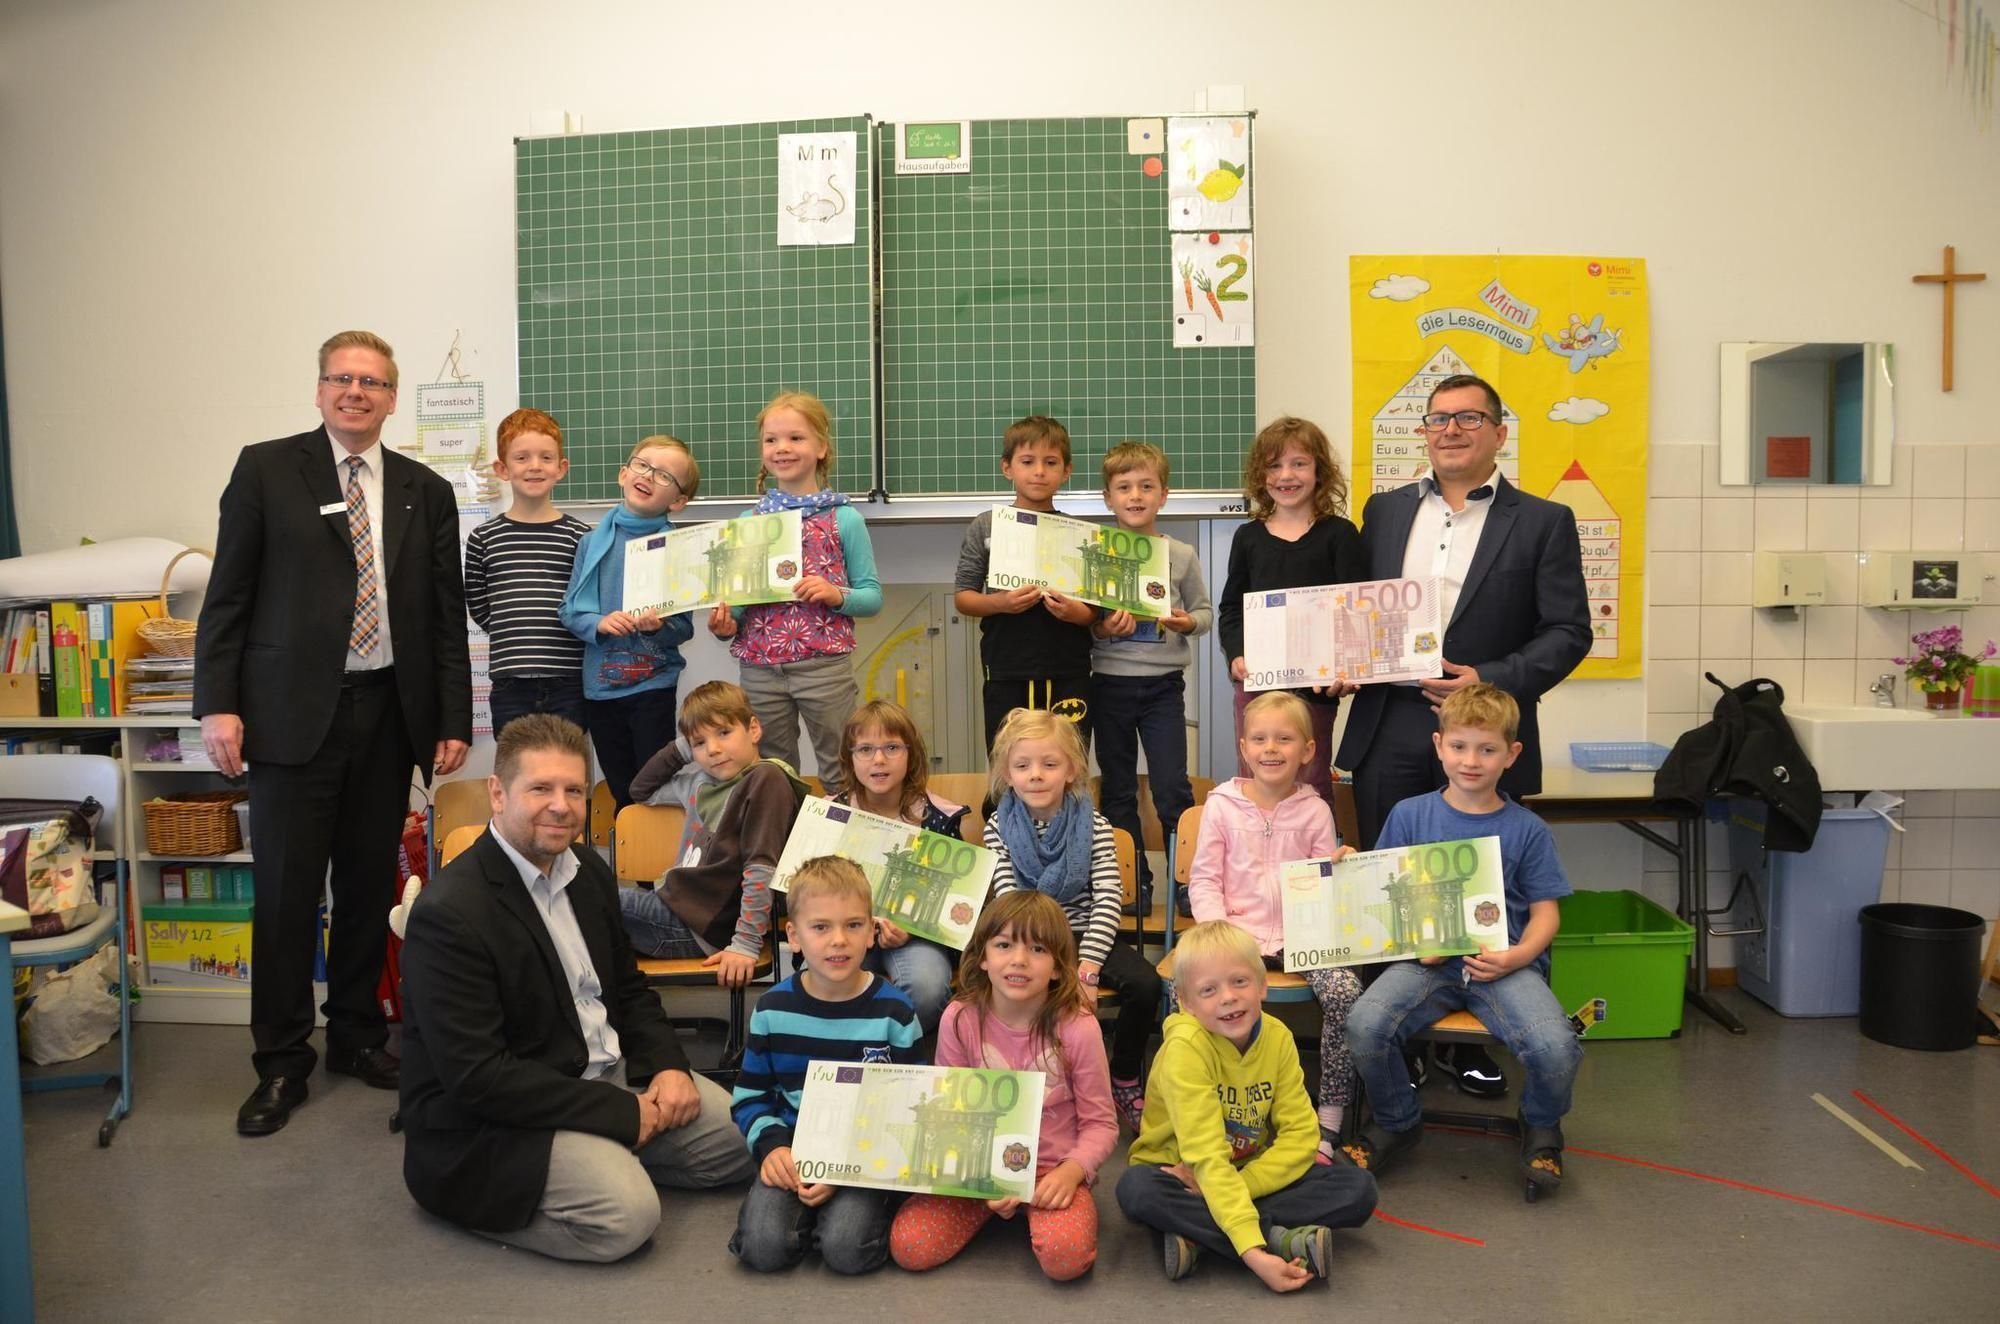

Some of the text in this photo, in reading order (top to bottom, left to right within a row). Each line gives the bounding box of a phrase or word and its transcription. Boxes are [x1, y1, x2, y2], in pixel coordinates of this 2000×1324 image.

[797, 145, 838, 161] M m
[898, 161, 969, 173] Hausaufgaben
[1216, 254, 1249, 301] 2
[1485, 286, 1531, 325] Mimi
[1421, 312, 1523, 349] die Lesemaus
[1423, 378, 1431, 388] E
[426, 397, 474, 407] fantastisch
[1405, 403, 1423, 413] A a
[1376, 424, 1408, 434] Au au
[439, 439, 464, 448] super
[1376, 444, 1408, 454] Eu eu
[1376, 464, 1400, 475] Ei ei
[1578, 525, 1603, 536] St st
[1102, 528, 1153, 562] 100
[1595, 547, 1609, 557] qu
[1592, 566, 1602, 577] pf
[994, 573, 1048, 588] 100 EURO
[1357, 580, 1423, 613] 500
[1246, 668, 1304, 687] 500 EURO
[918, 834, 977, 877] 100
[1410, 843, 1479, 880] 100
[779, 873, 793, 889] 10
[150, 922, 188, 944] Sally
[192, 928, 212, 942] 1/2
[1290, 946, 1351, 968] 100 EURO
[946, 1072, 1020, 1113] 100
[1245, 1081, 1272, 1105] 1982
[1229, 1107, 1247, 1120] EST
[796, 1160, 862, 1179] 100 EURO
